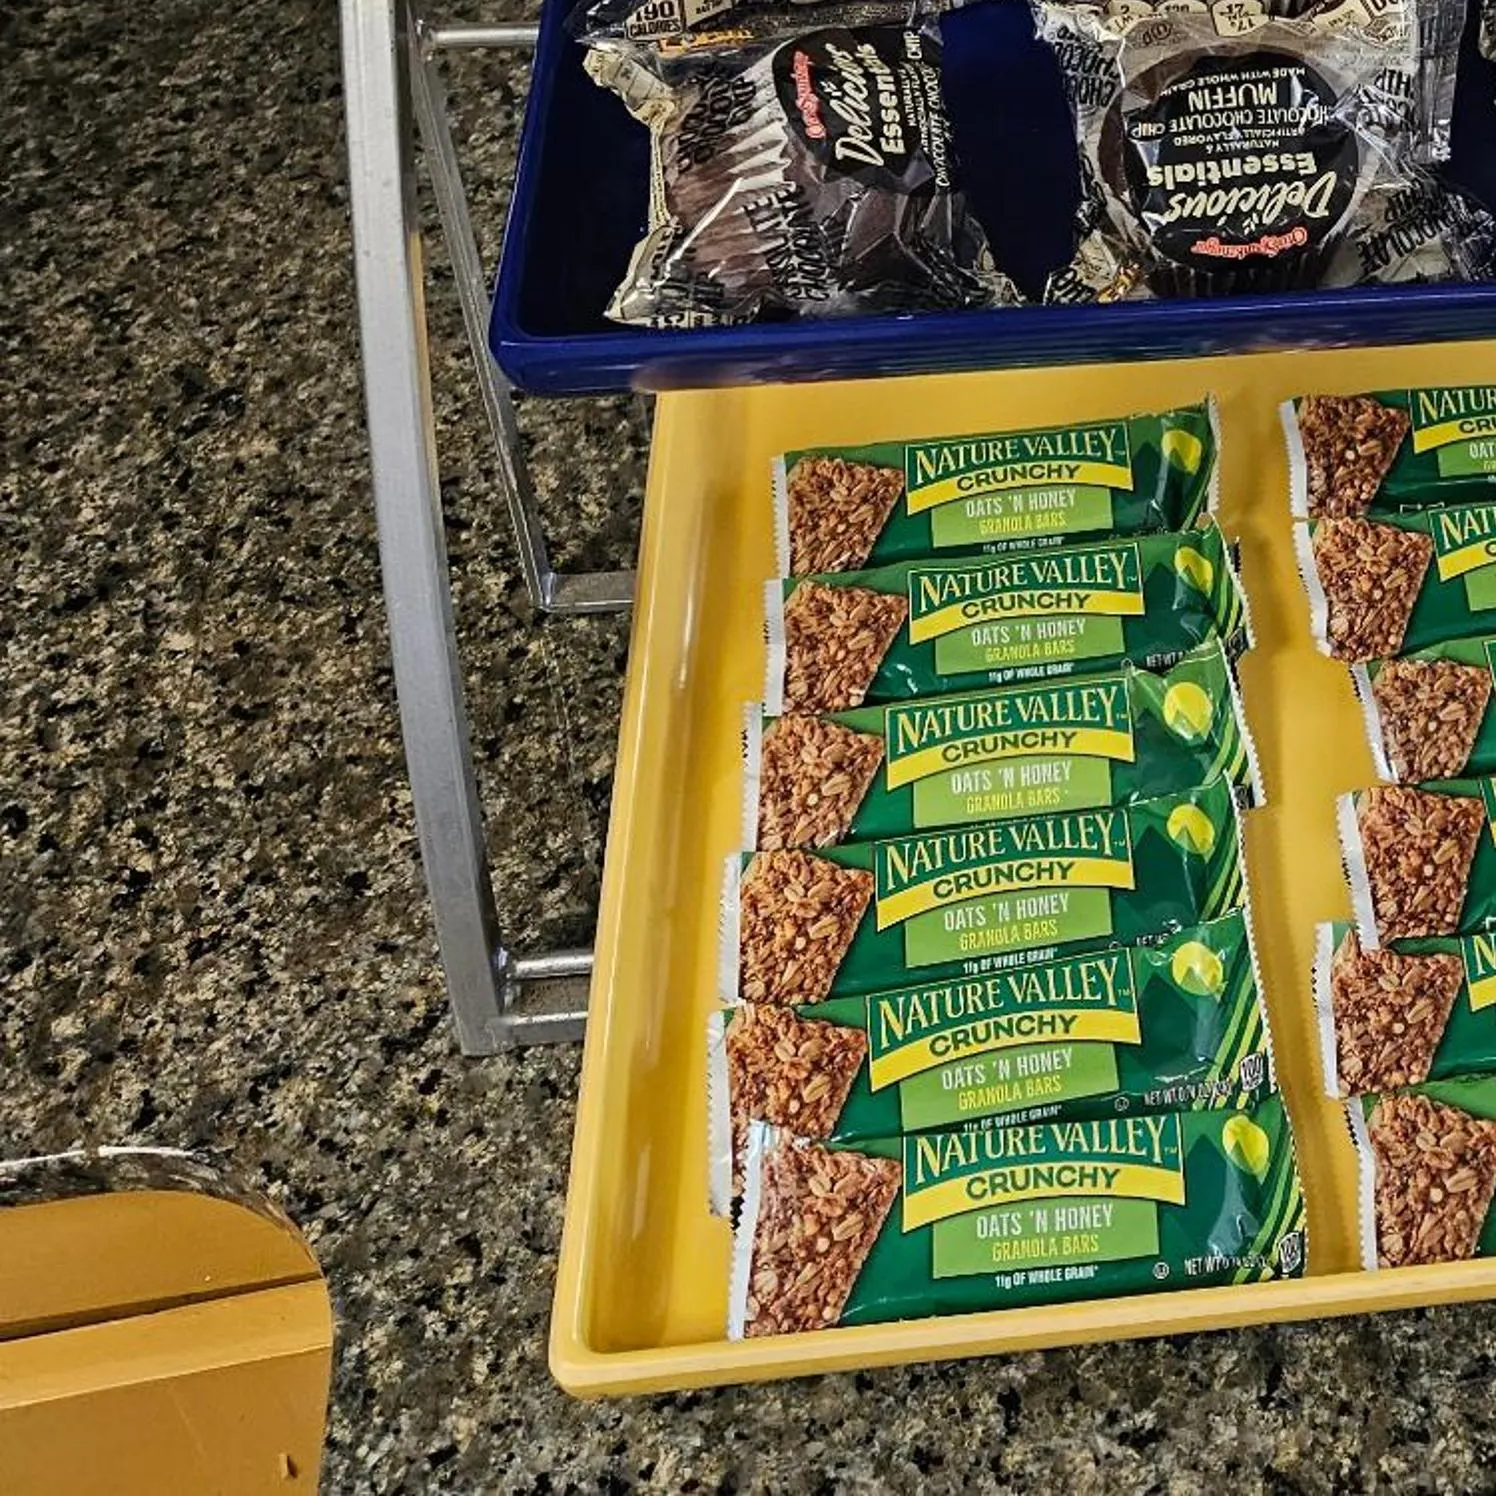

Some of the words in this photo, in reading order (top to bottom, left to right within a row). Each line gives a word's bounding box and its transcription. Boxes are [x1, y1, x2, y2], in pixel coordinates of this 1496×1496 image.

[635, 0, 675, 22] 190
[630, 19, 683, 37] CALORIES
[1197, 73, 1238, 85] WHOLE
[1272, 67, 1305, 77] MADE
[1187, 81, 1278, 111] MUFFIN
[1130, 122, 1165, 138] CHIP
[1169, 108, 1253, 131] CHOCOLATE
[1206, 143, 1213, 153] &
[1216, 139, 1279, 152] NATURALLY
[1146, 151, 1317, 190] Essentials
[1165, 171, 1337, 226] Delicious
[916, 438, 1018, 485] NATURE
[1023, 427, 1116, 462] VALLEY
[956, 463, 1081, 492] CRUNCHY
[965, 496, 1001, 518] OATS
[1028, 488, 1076, 511] HONEY
[919, 563, 1028, 613] NATURE
[1032, 552, 1128, 590] VALLEY
[961, 592, 1092, 620] CRUNCHY
[971, 623, 1011, 647] OATS
[1036, 618, 1086, 640] HONEY
[897, 700, 1012, 755] NATURE
[1018, 686, 1118, 728] VALLEY
[941, 731, 1078, 764] CRUNCHY
[951, 770, 991, 795] OATS
[1020, 761, 1072, 786] HONEY
[966, 792, 1025, 814] GRANOLA
[886, 831, 1006, 893] NATURE
[1010, 811, 1114, 858] VALLEY
[932, 861, 1075, 899] CRUNCHY
[944, 906, 987, 933] OATS
[1016, 893, 1070, 920] HONEY
[959, 929, 1020, 951] GRANOLA
[878, 985, 1005, 1050] NATURE
[1008, 956, 1119, 1007] VALLEY
[928, 1013, 1079, 1058] CRUNCHY
[941, 1062, 985, 1090] OATS
[1017, 1048, 1074, 1078] HONEY
[957, 1086, 1023, 1110] GRANOLA
[914, 1125, 1046, 1185] NATURE
[1055, 1112, 1167, 1165] VALLEY
[965, 1164, 1121, 1202] CRUNCHY
[976, 1210, 1022, 1239] OATS
[1055, 1202, 1114, 1231] HONEY
[992, 1240, 1058, 1262] GRANOLA
[1062, 1235, 1099, 1258] BARS
[1013, 1272, 1027, 1286] OF
[1027, 1268, 1063, 1285] WHOLE
